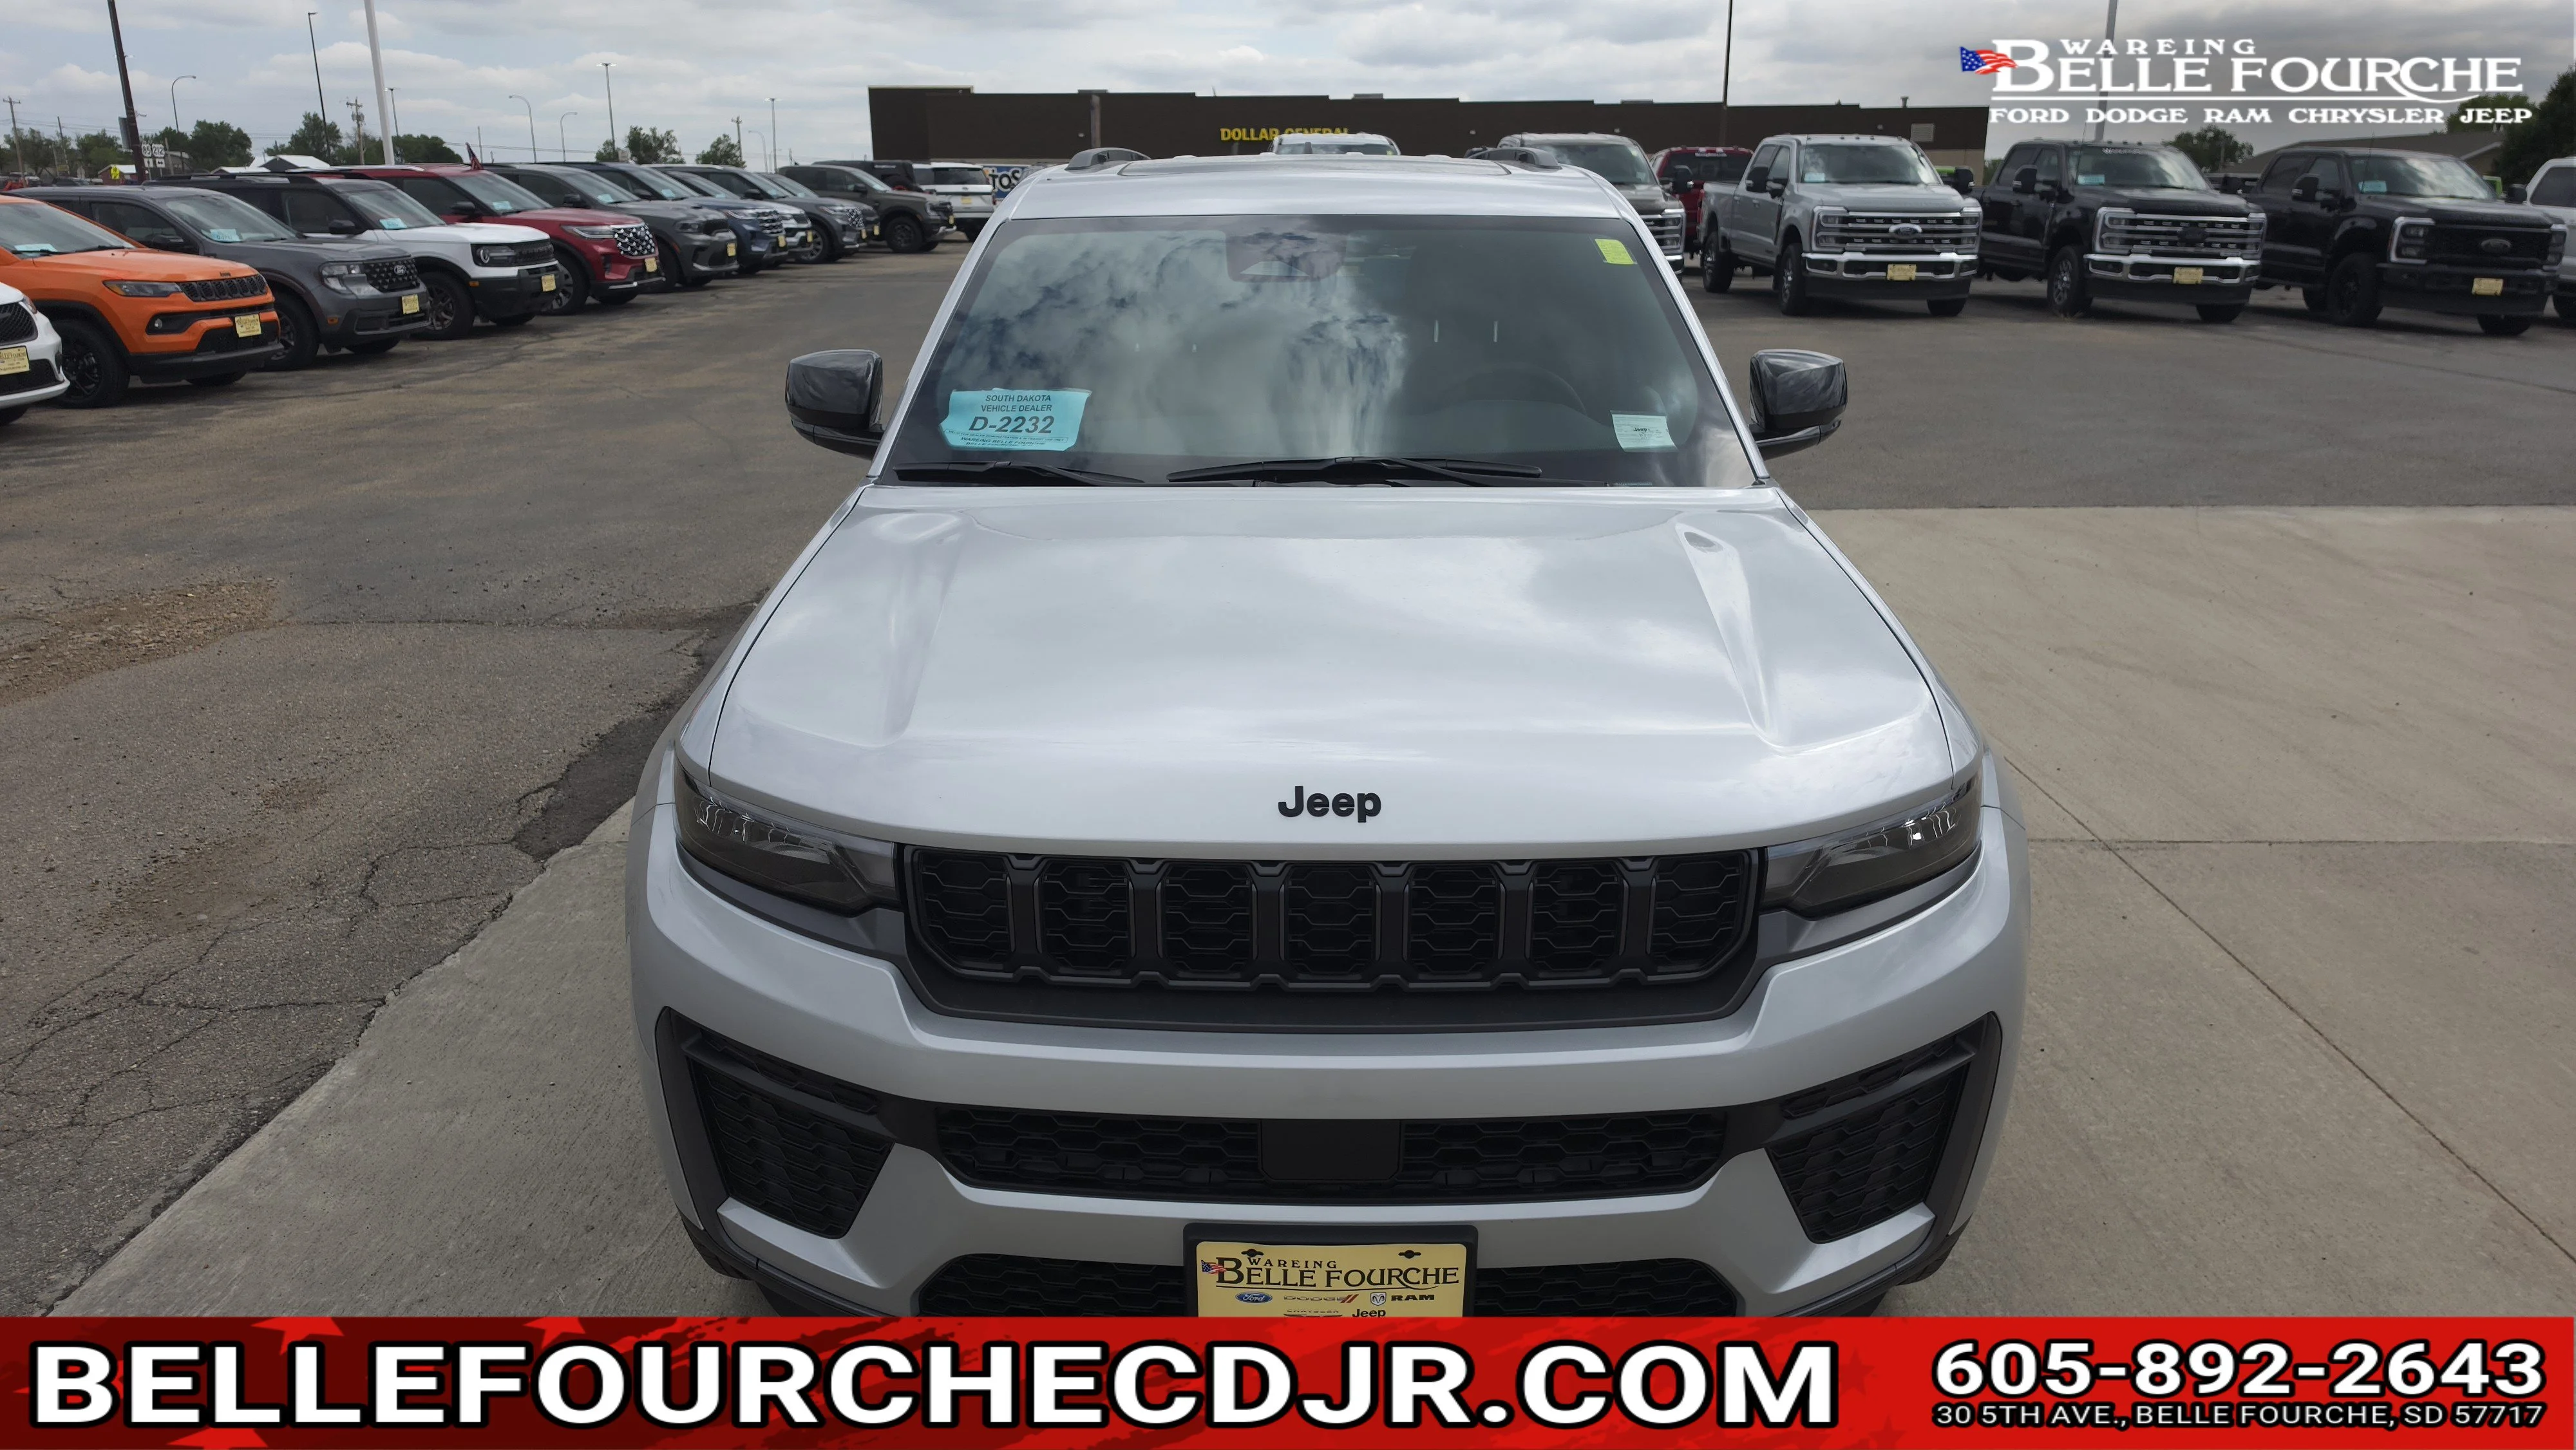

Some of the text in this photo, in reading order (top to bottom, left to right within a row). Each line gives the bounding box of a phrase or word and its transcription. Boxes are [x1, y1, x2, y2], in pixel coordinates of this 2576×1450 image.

[1220, 127, 1280, 140] DOLLAR
[142, 146, 151, 155] 85
[153, 146, 164, 155] 212
[968, 416, 1055, 434] D-2232
[1278, 786, 1381, 823] Jeep
[1247, 1257, 1337, 1269] WAREING
[1216, 1257, 1459, 1288] BELLE FOURCHE
[1242, 1292, 1265, 1302] Ford
[1352, 1308, 1386, 1318] Jeep
